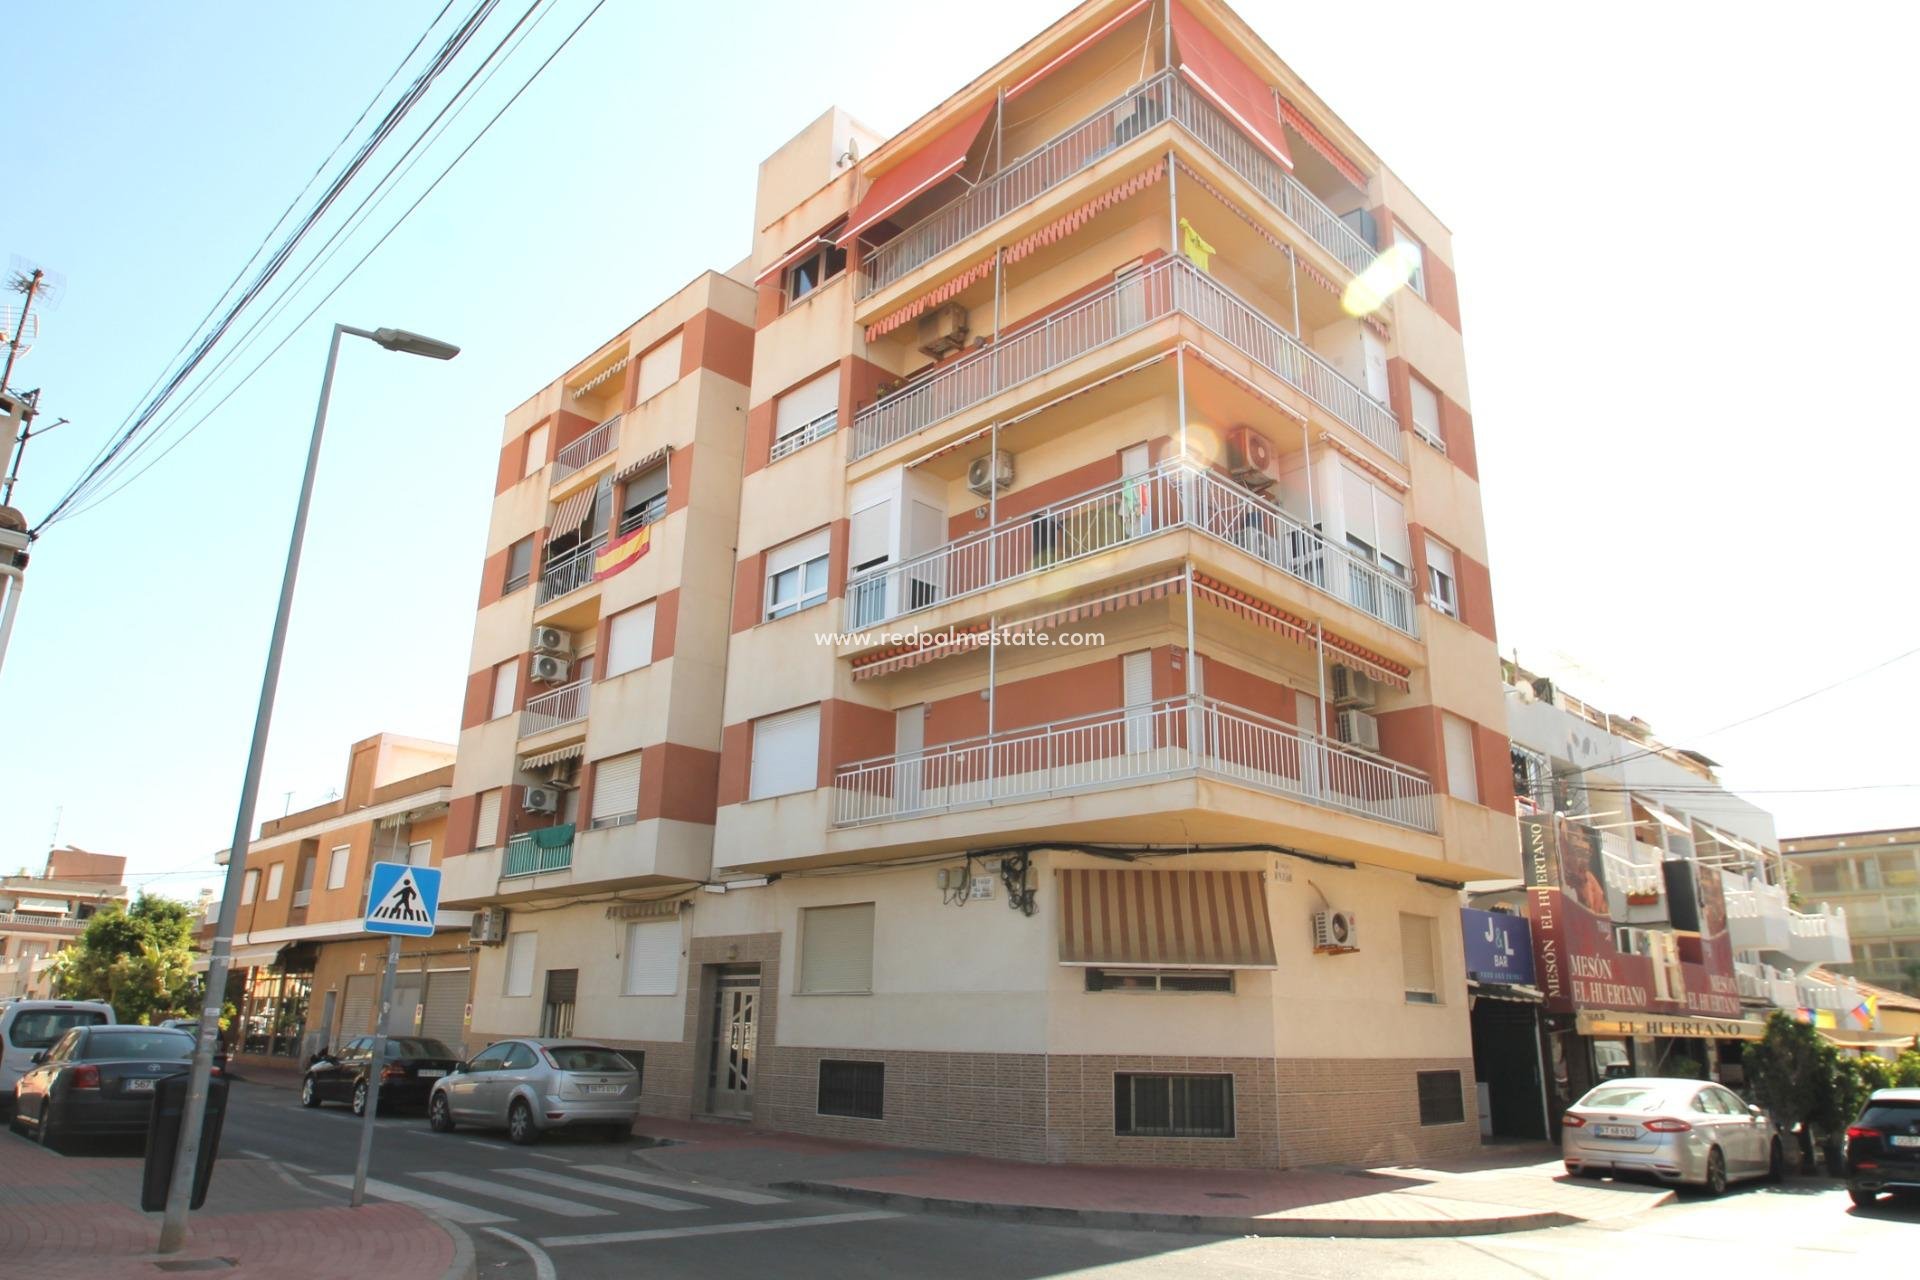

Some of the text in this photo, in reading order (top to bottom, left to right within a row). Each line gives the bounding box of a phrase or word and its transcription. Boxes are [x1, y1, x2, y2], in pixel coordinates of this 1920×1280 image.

[1530, 823, 1562, 998] MESÓN EL HUERTANO
[1494, 954, 1509, 968] BAR
[1570, 953, 1613, 979] MESÓN
[1572, 980, 1647, 1007] EL HUERTANO
[1686, 991, 1699, 1010] EL
[1619, 1020, 1742, 1037] EL HUERTANO
